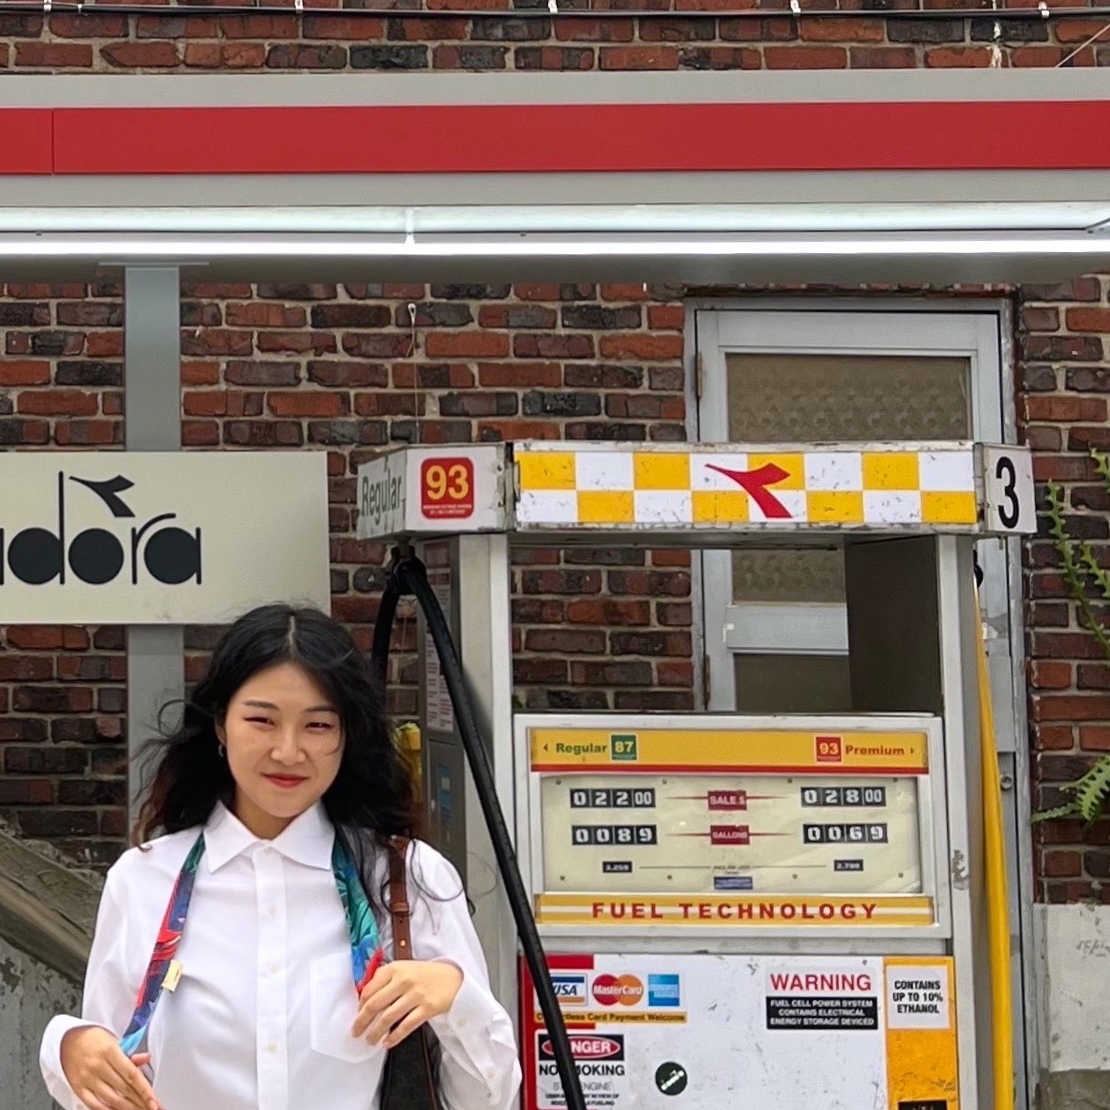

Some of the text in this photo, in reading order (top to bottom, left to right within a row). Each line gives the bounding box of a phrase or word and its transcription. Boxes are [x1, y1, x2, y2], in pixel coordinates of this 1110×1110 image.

[425, 464, 470, 500] 93
[361, 468, 402, 526] Regular
[995, 456, 1020, 529] 3
[556, 741, 634, 755] Regular 87
[819, 742, 905, 756] 93 Premium
[710, 795, 737, 805] SALE
[712, 831, 748, 839] GALLONS
[591, 902, 878, 919] FUEL TECHNOLOGY
[770, 974, 872, 991] WARNING
[894, 980, 941, 990] CONTAINS
[593, 985, 642, 996] MasterCard
[892, 992, 943, 1002] UP TO 10%
[897, 1004, 940, 1013] ETHANOL
[587, 1012, 608, 1021] Card
[609, 1012, 646, 1023] Payment
[647, 1012, 685, 1021] Welcome
[570, 1041, 611, 1053] NGER
[539, 1065, 625, 1076] NO OKING
